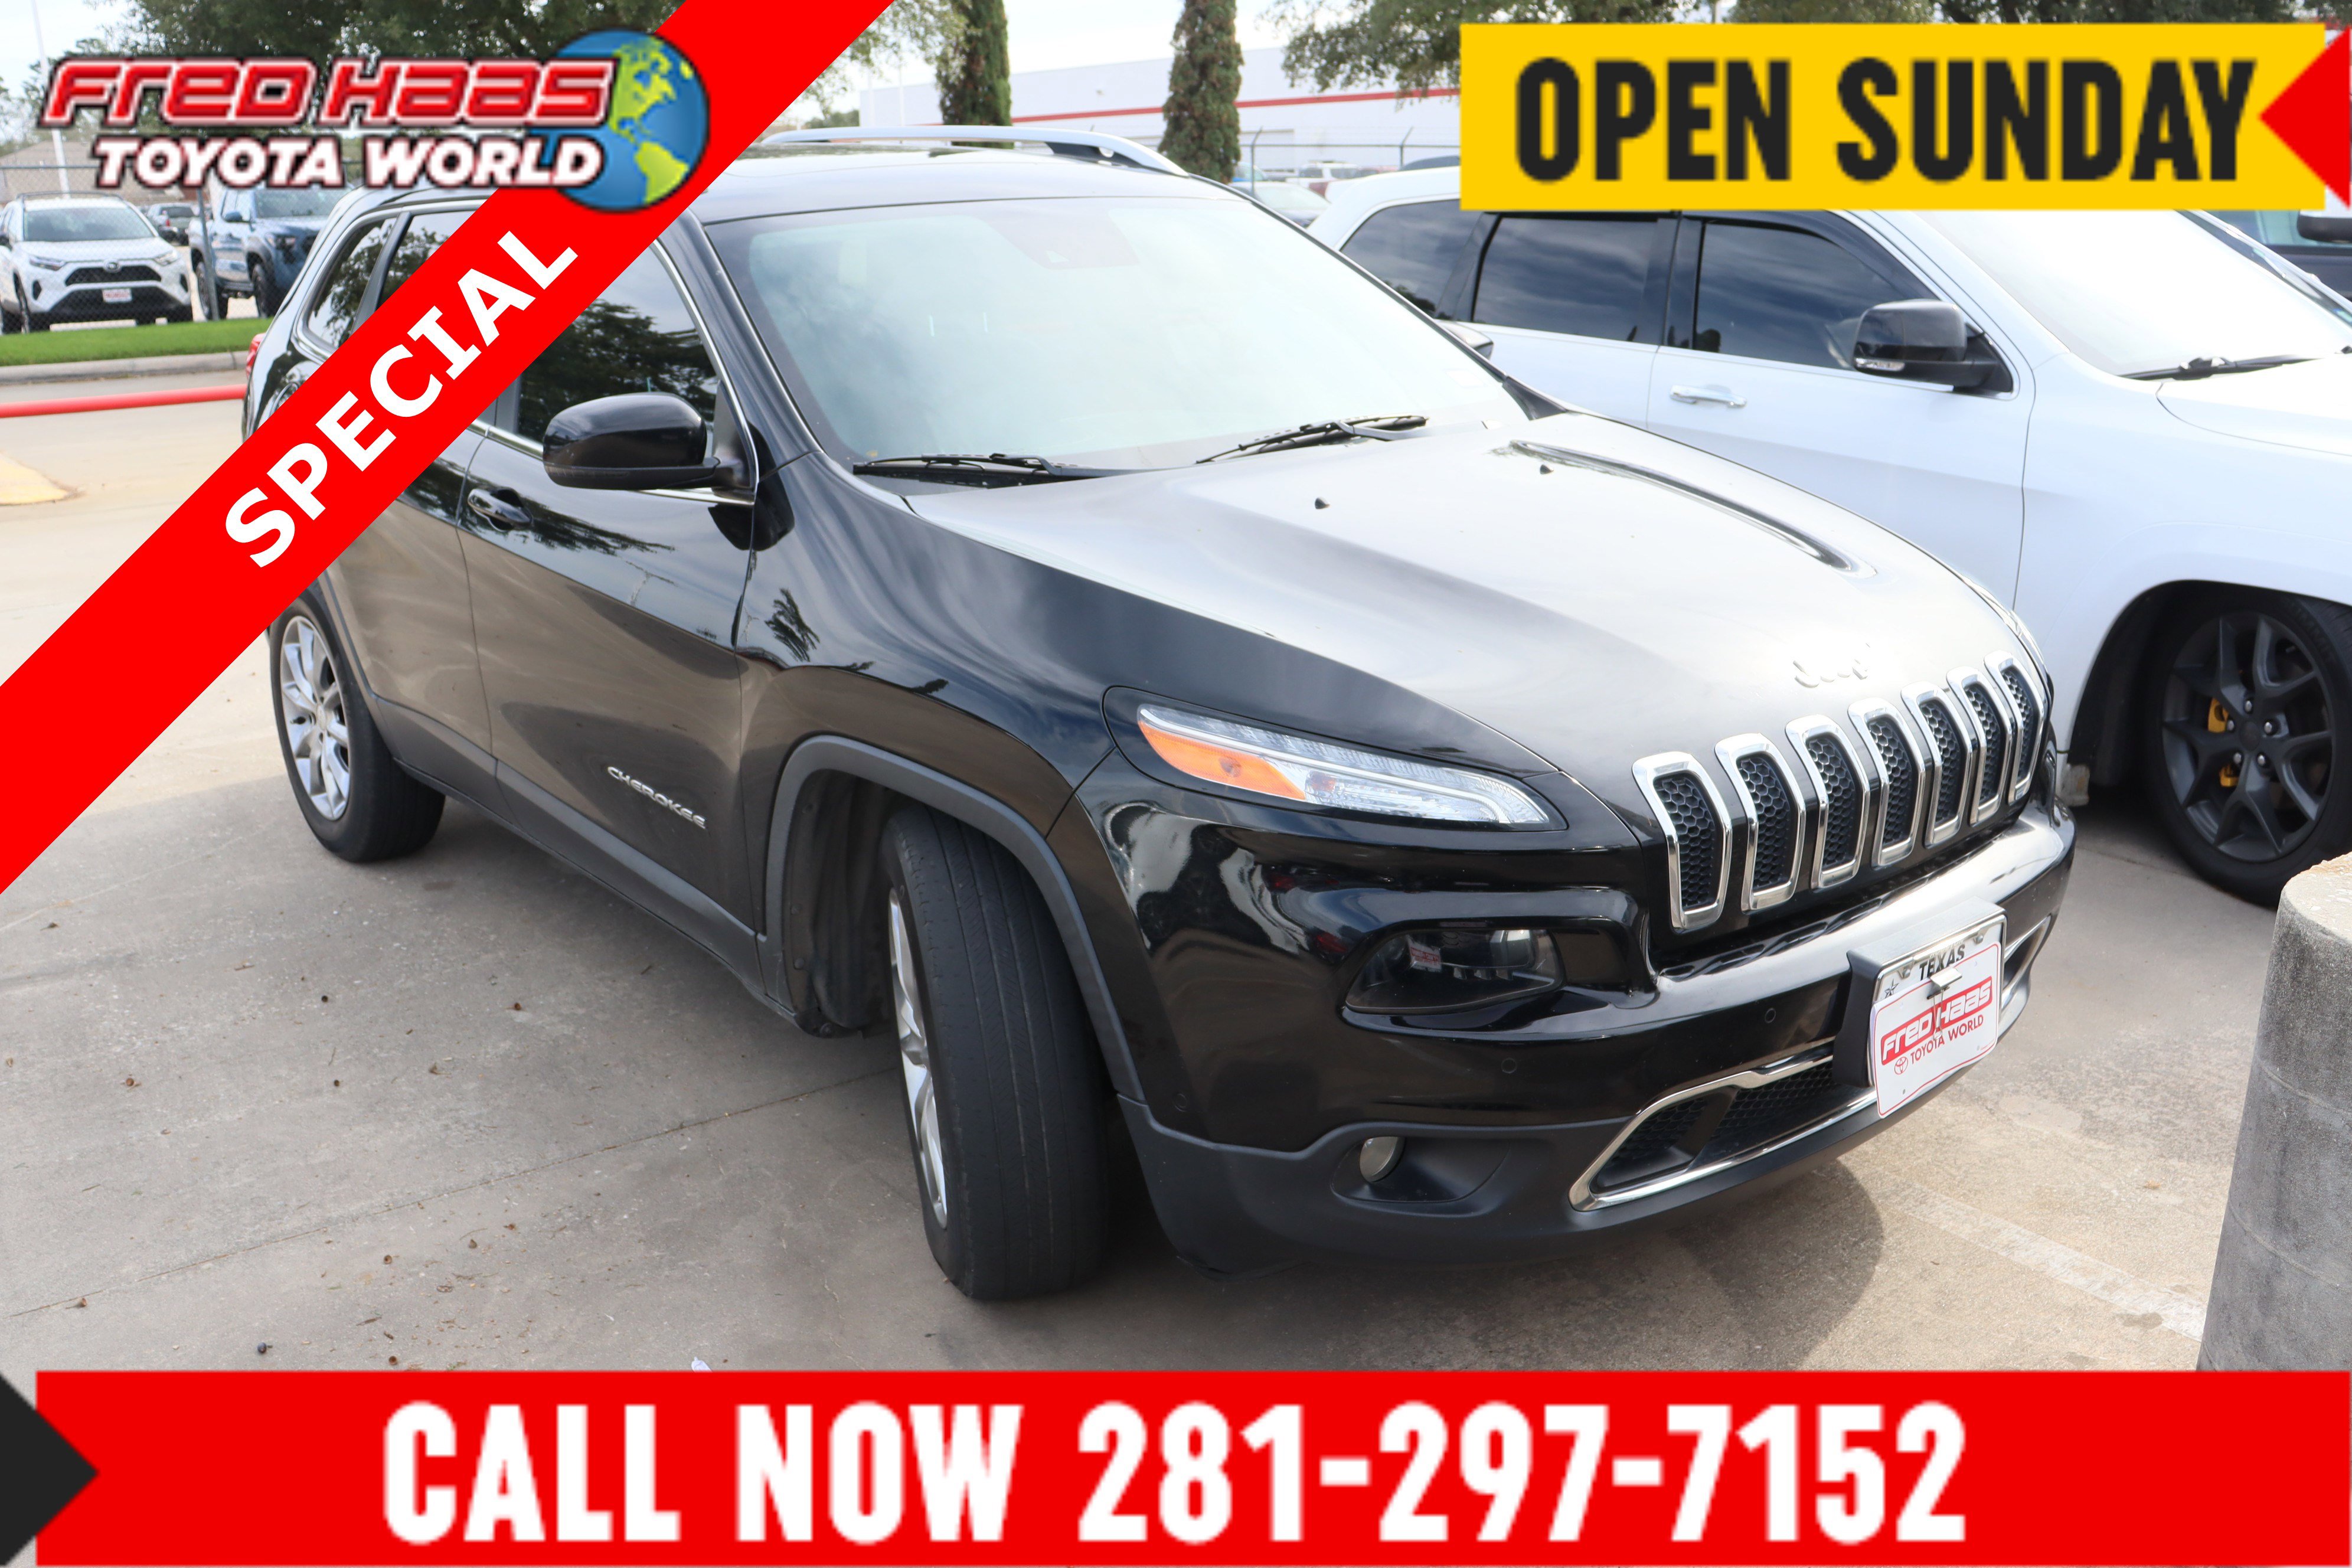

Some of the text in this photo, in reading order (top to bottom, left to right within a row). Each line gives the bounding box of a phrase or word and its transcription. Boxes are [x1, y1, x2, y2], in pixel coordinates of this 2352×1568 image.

[607, 766, 705, 829] CHEROKEE
[1919, 944, 1966, 981] TEXAS
[1910, 1014, 1984, 1064] TOYOTA WORLD
